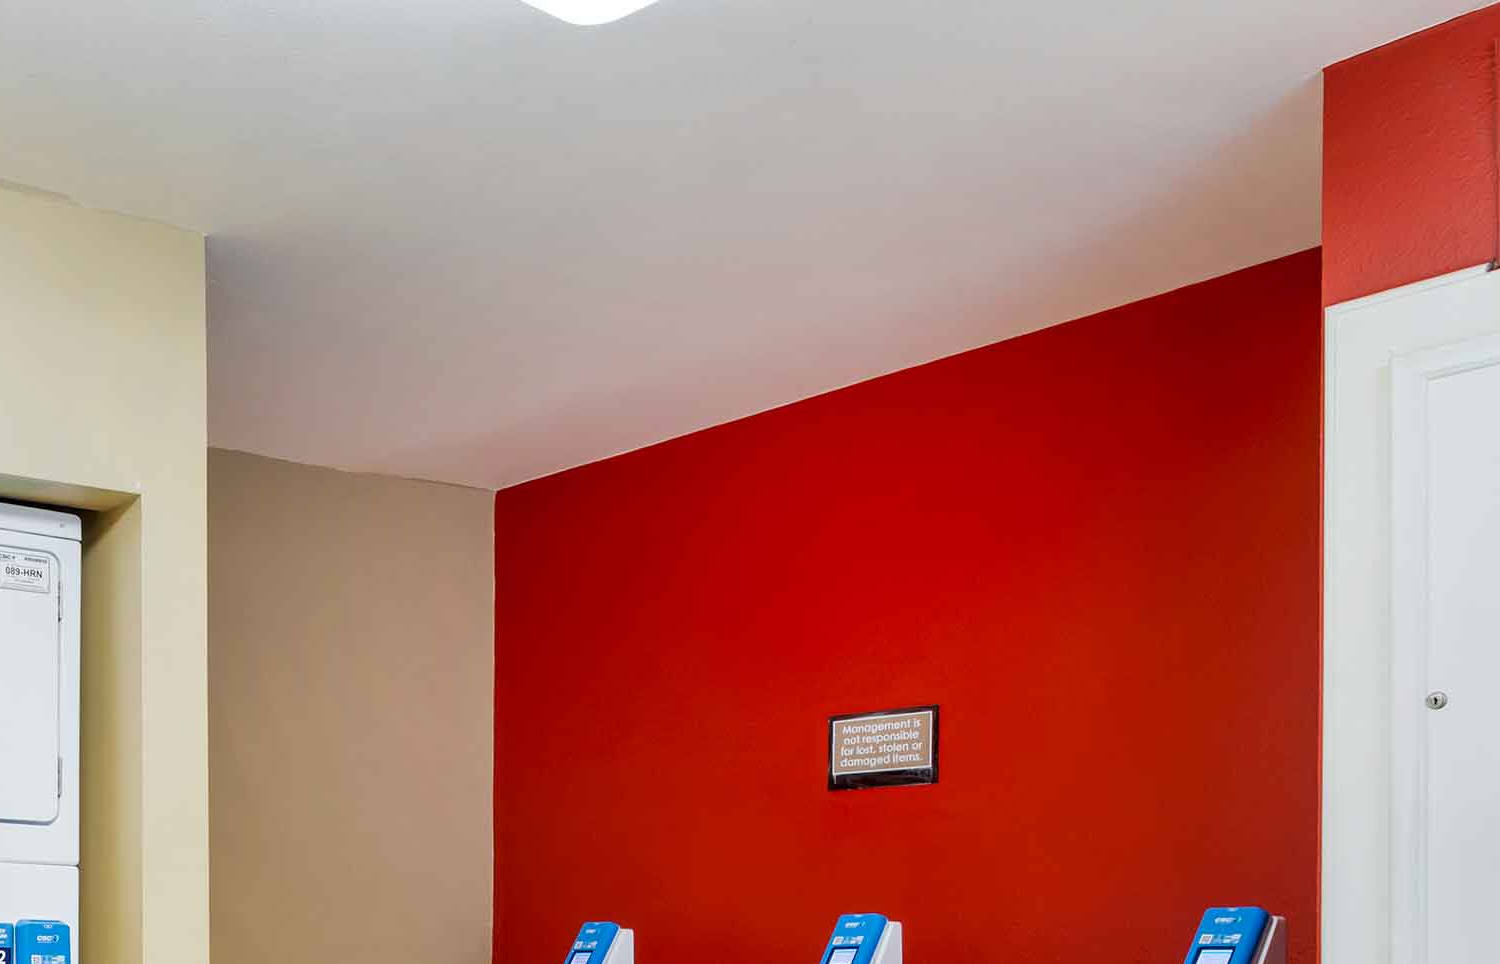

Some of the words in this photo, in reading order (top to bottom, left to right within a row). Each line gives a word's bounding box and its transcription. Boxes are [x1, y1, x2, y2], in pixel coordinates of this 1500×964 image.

[5, 566, 43, 578] 089-HRN
[843, 720, 910, 734] Management
[911, 718, 921, 729] is
[844, 736, 860, 746] not
[862, 730, 920, 744] responsible
[841, 746, 854, 756] for
[856, 744, 876, 756] lost,
[879, 742, 909, 754] stolen
[911, 742, 923, 750] or
[840, 754, 891, 768] damaged
[892, 752, 923, 764] items.
